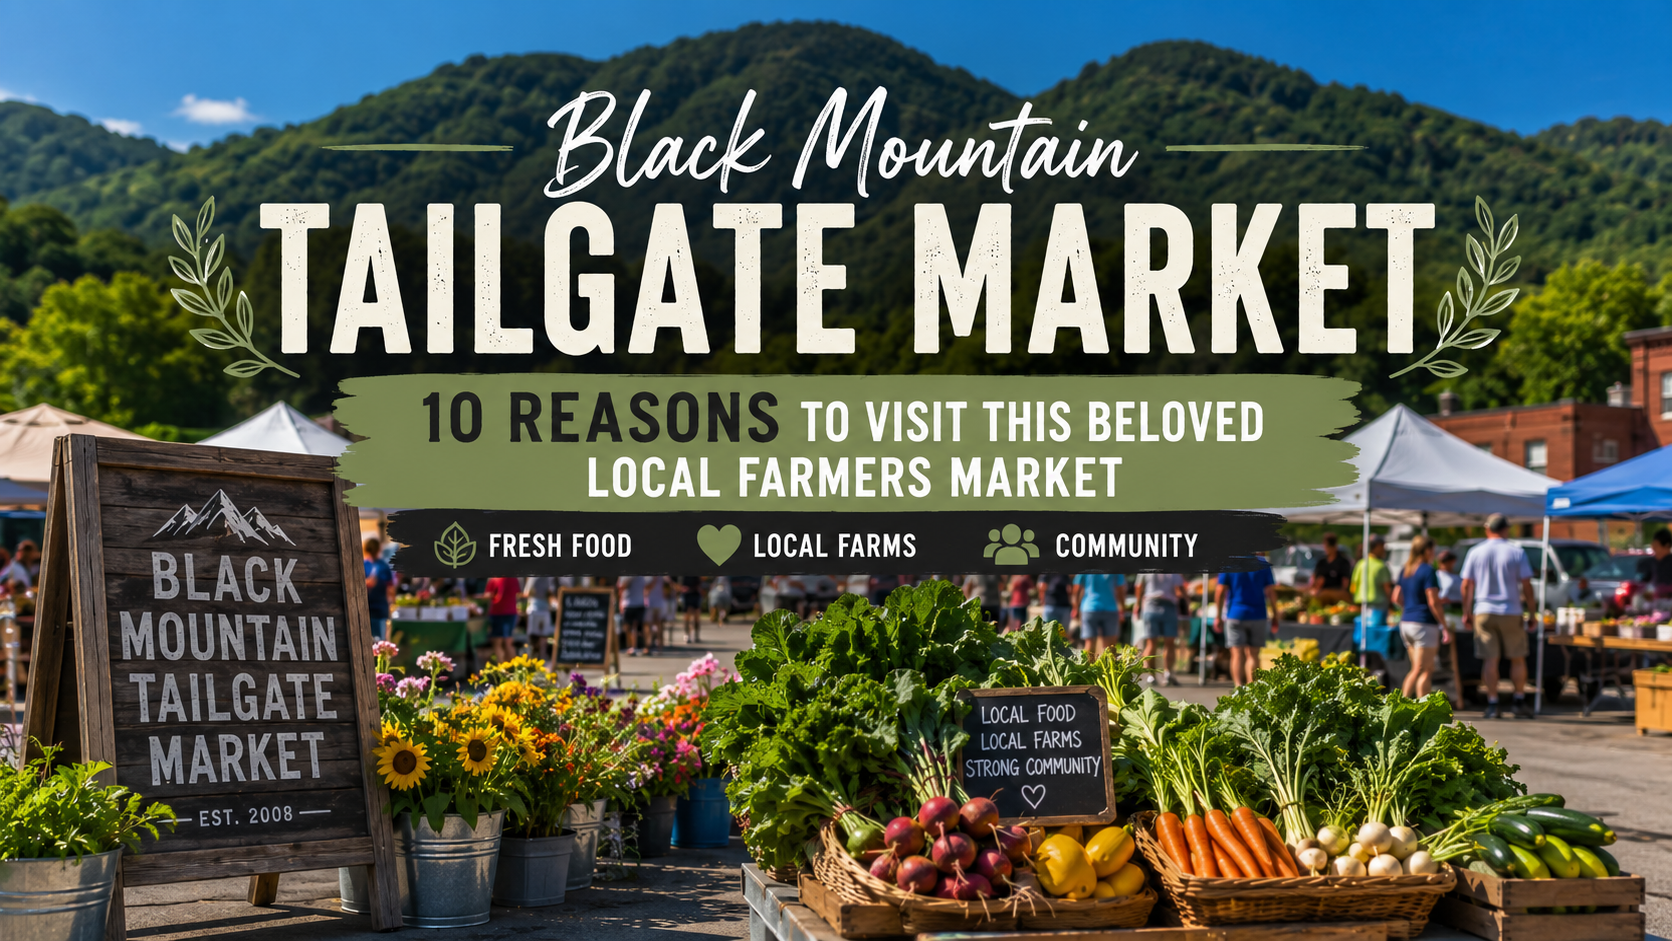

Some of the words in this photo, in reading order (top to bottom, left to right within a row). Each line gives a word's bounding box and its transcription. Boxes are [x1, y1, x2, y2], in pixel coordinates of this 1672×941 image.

[151, 551, 303, 604] BLACK
[119, 610, 338, 661] MOUNTAIN
[129, 672, 338, 723] TAILGATE
[981, 705, 1030, 725] LOCAL
[1037, 703, 1076, 723] FOOD
[148, 731, 325, 786] MARKET
[981, 732, 1027, 751] LOCAL
[1033, 730, 1082, 750] FARMS
[965, 758, 1020, 778] STRONG
[1025, 755, 1102, 778] COMMUNITY
[199, 808, 239, 827] EST.
[248, 805, 293, 824] 2008
